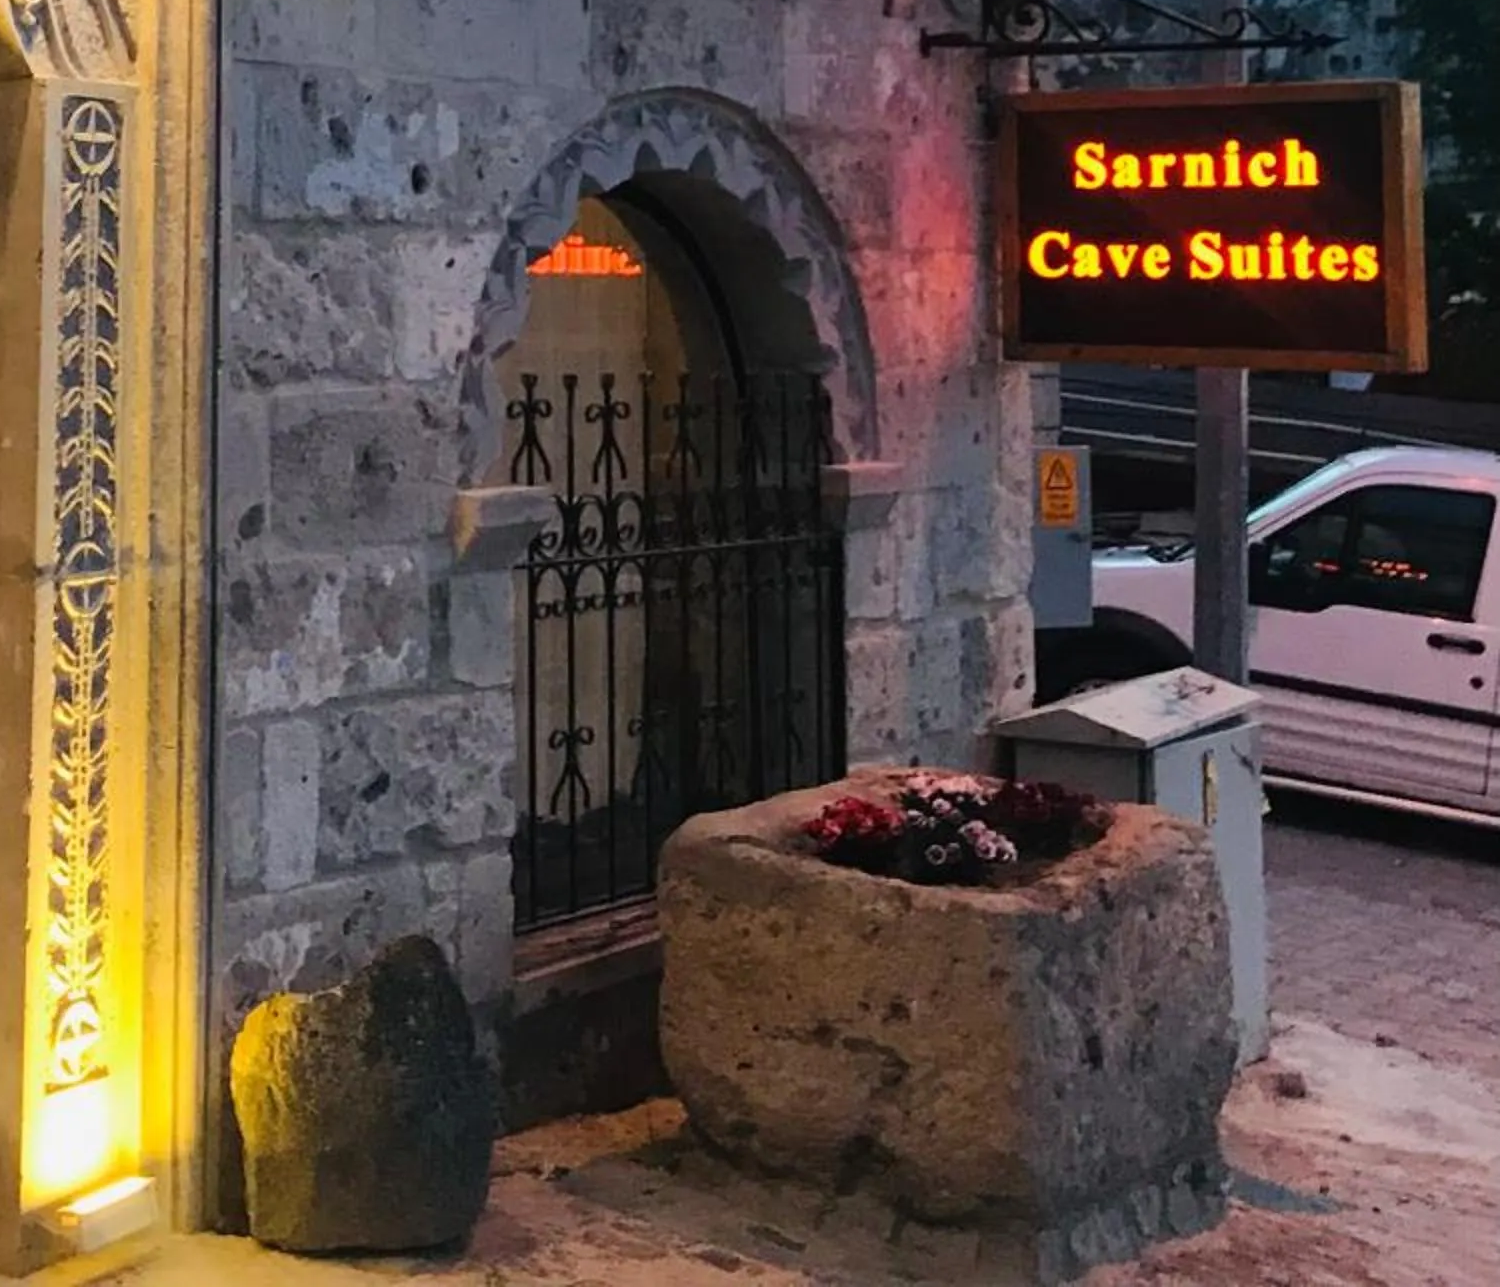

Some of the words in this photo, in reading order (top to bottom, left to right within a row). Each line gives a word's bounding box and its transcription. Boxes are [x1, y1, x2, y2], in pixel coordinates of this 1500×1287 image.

[1073, 138, 1320, 190] Sarnich
[1027, 229, 1171, 280] Cave
[1188, 230, 1380, 282] Suites
